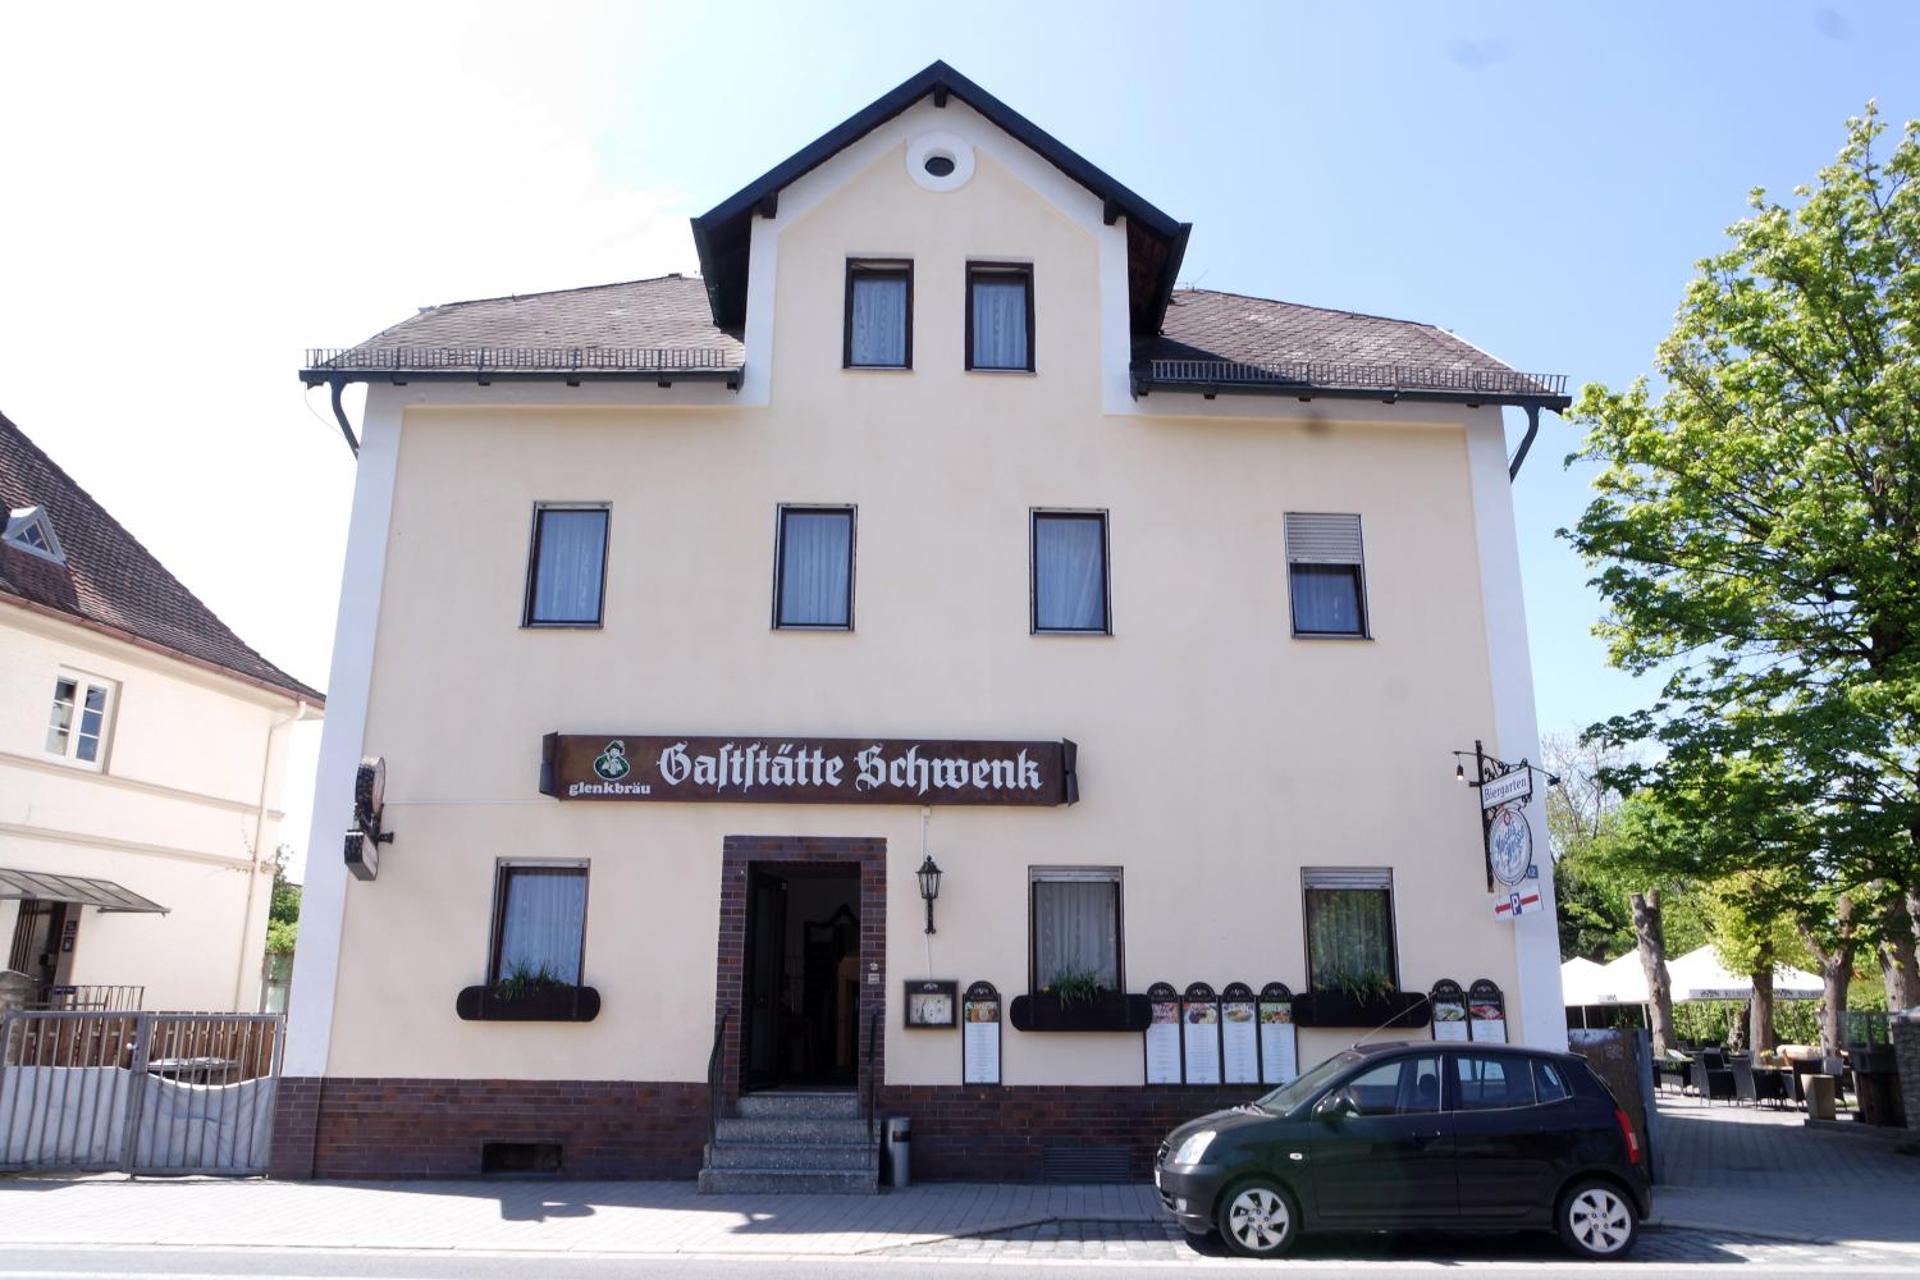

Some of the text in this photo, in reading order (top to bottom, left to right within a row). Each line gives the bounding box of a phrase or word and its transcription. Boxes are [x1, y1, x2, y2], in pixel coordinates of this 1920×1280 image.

[853, 742, 1044, 796] Schwenk
[569, 781, 651, 796] glenkbräu
[1484, 778, 1527, 801] Biergarten
[1511, 895, 1520, 914] P
